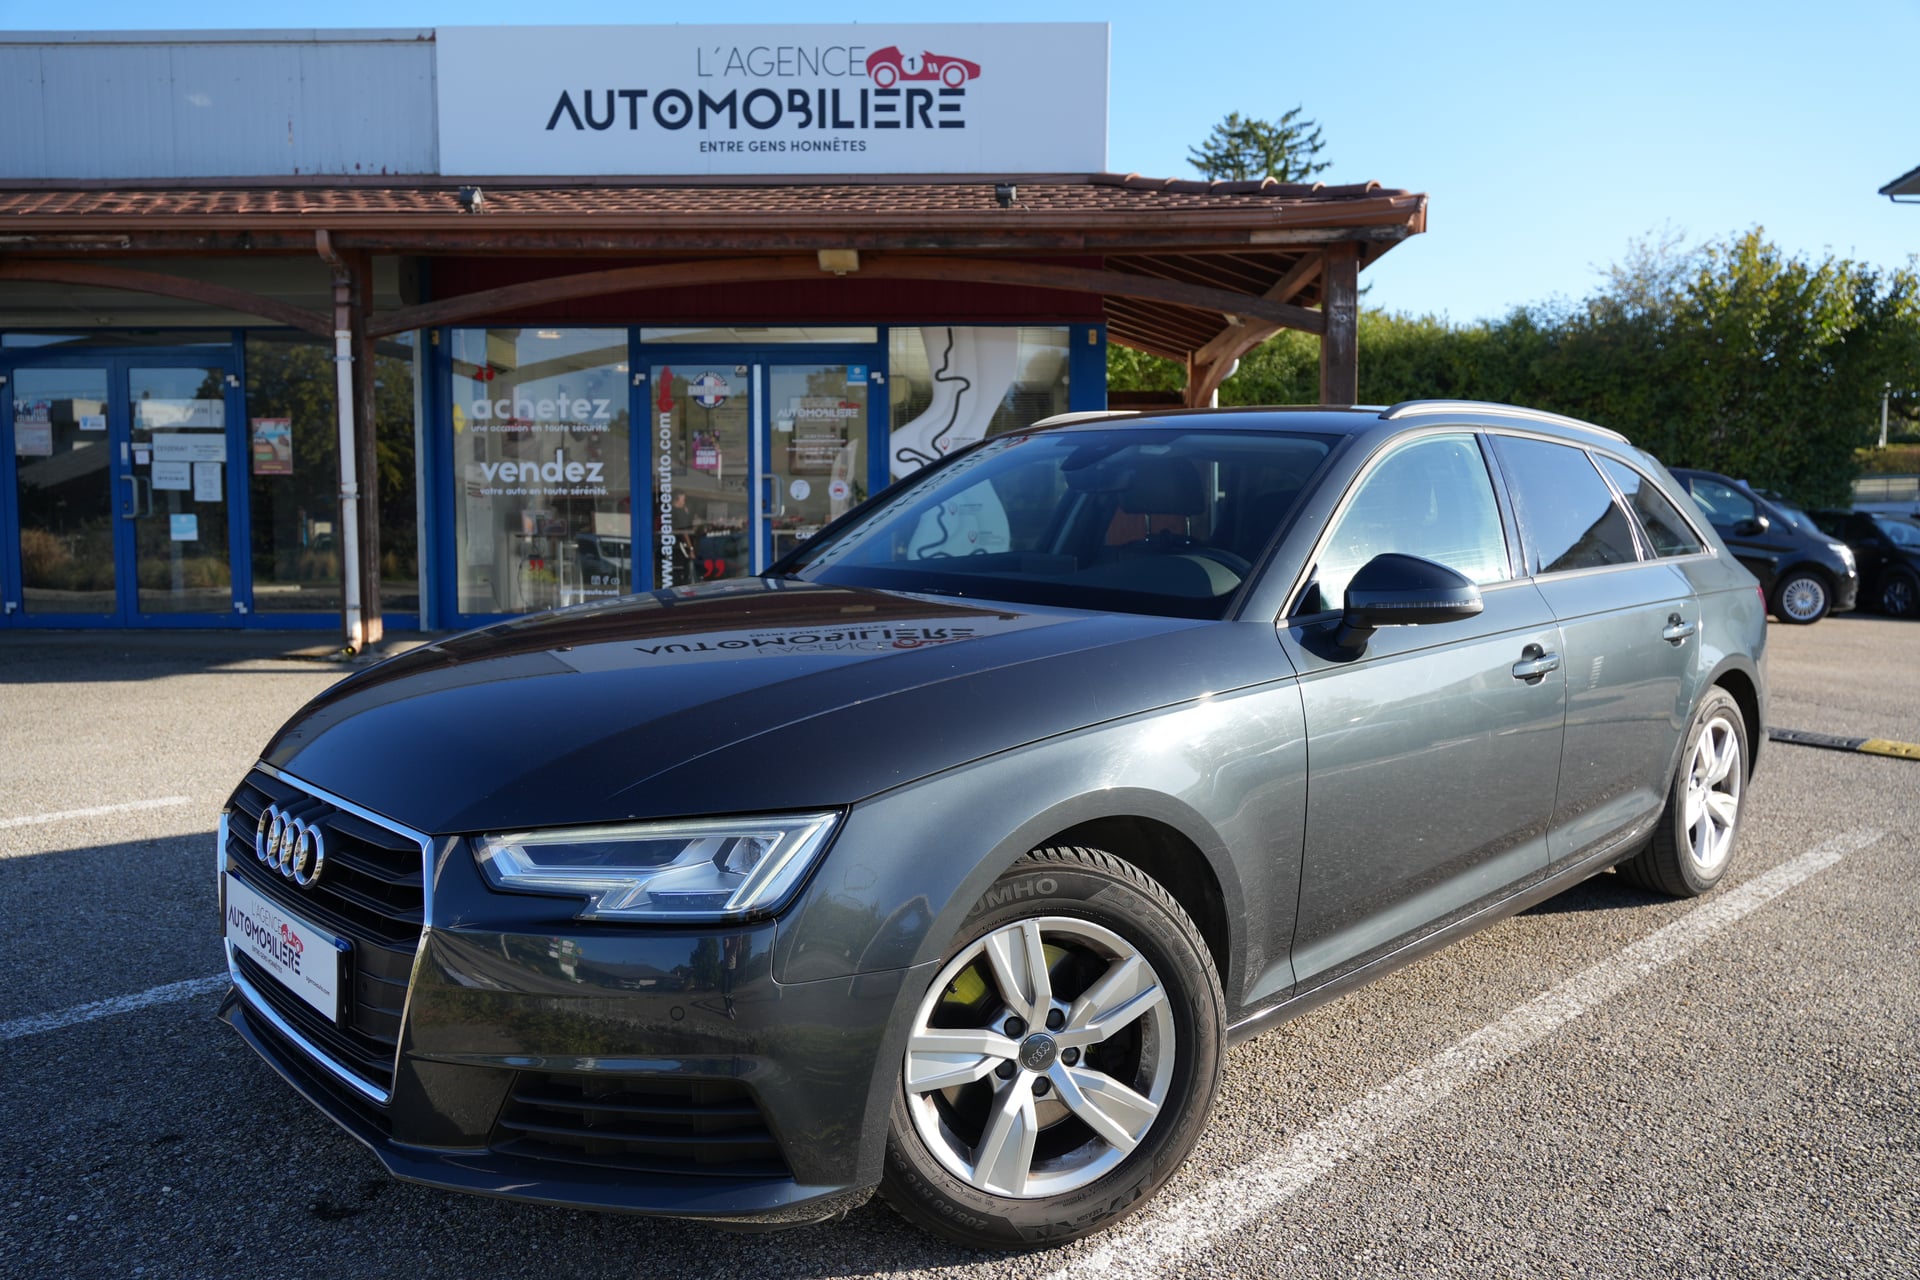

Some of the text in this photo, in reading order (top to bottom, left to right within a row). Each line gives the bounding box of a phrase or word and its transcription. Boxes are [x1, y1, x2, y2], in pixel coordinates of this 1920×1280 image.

[697, 46, 867, 78] L'AGENCE
[545, 88, 966, 131] AUTOMOBILIERE
[699, 136, 867, 153] ENTRE GENS HONNÊTES
[471, 388, 611, 419] achetez
[470, 424, 488, 432] une
[490, 424, 528, 432] occasion
[545, 424, 569, 432] toute
[480, 449, 604, 482] vendez
[480, 487, 503, 495] votre
[505, 487, 527, 495] auto
[543, 487, 567, 495] toute
[659, 412, 675, 589] ww.agenceauto.com
[968, 878, 1058, 916] UMHO
